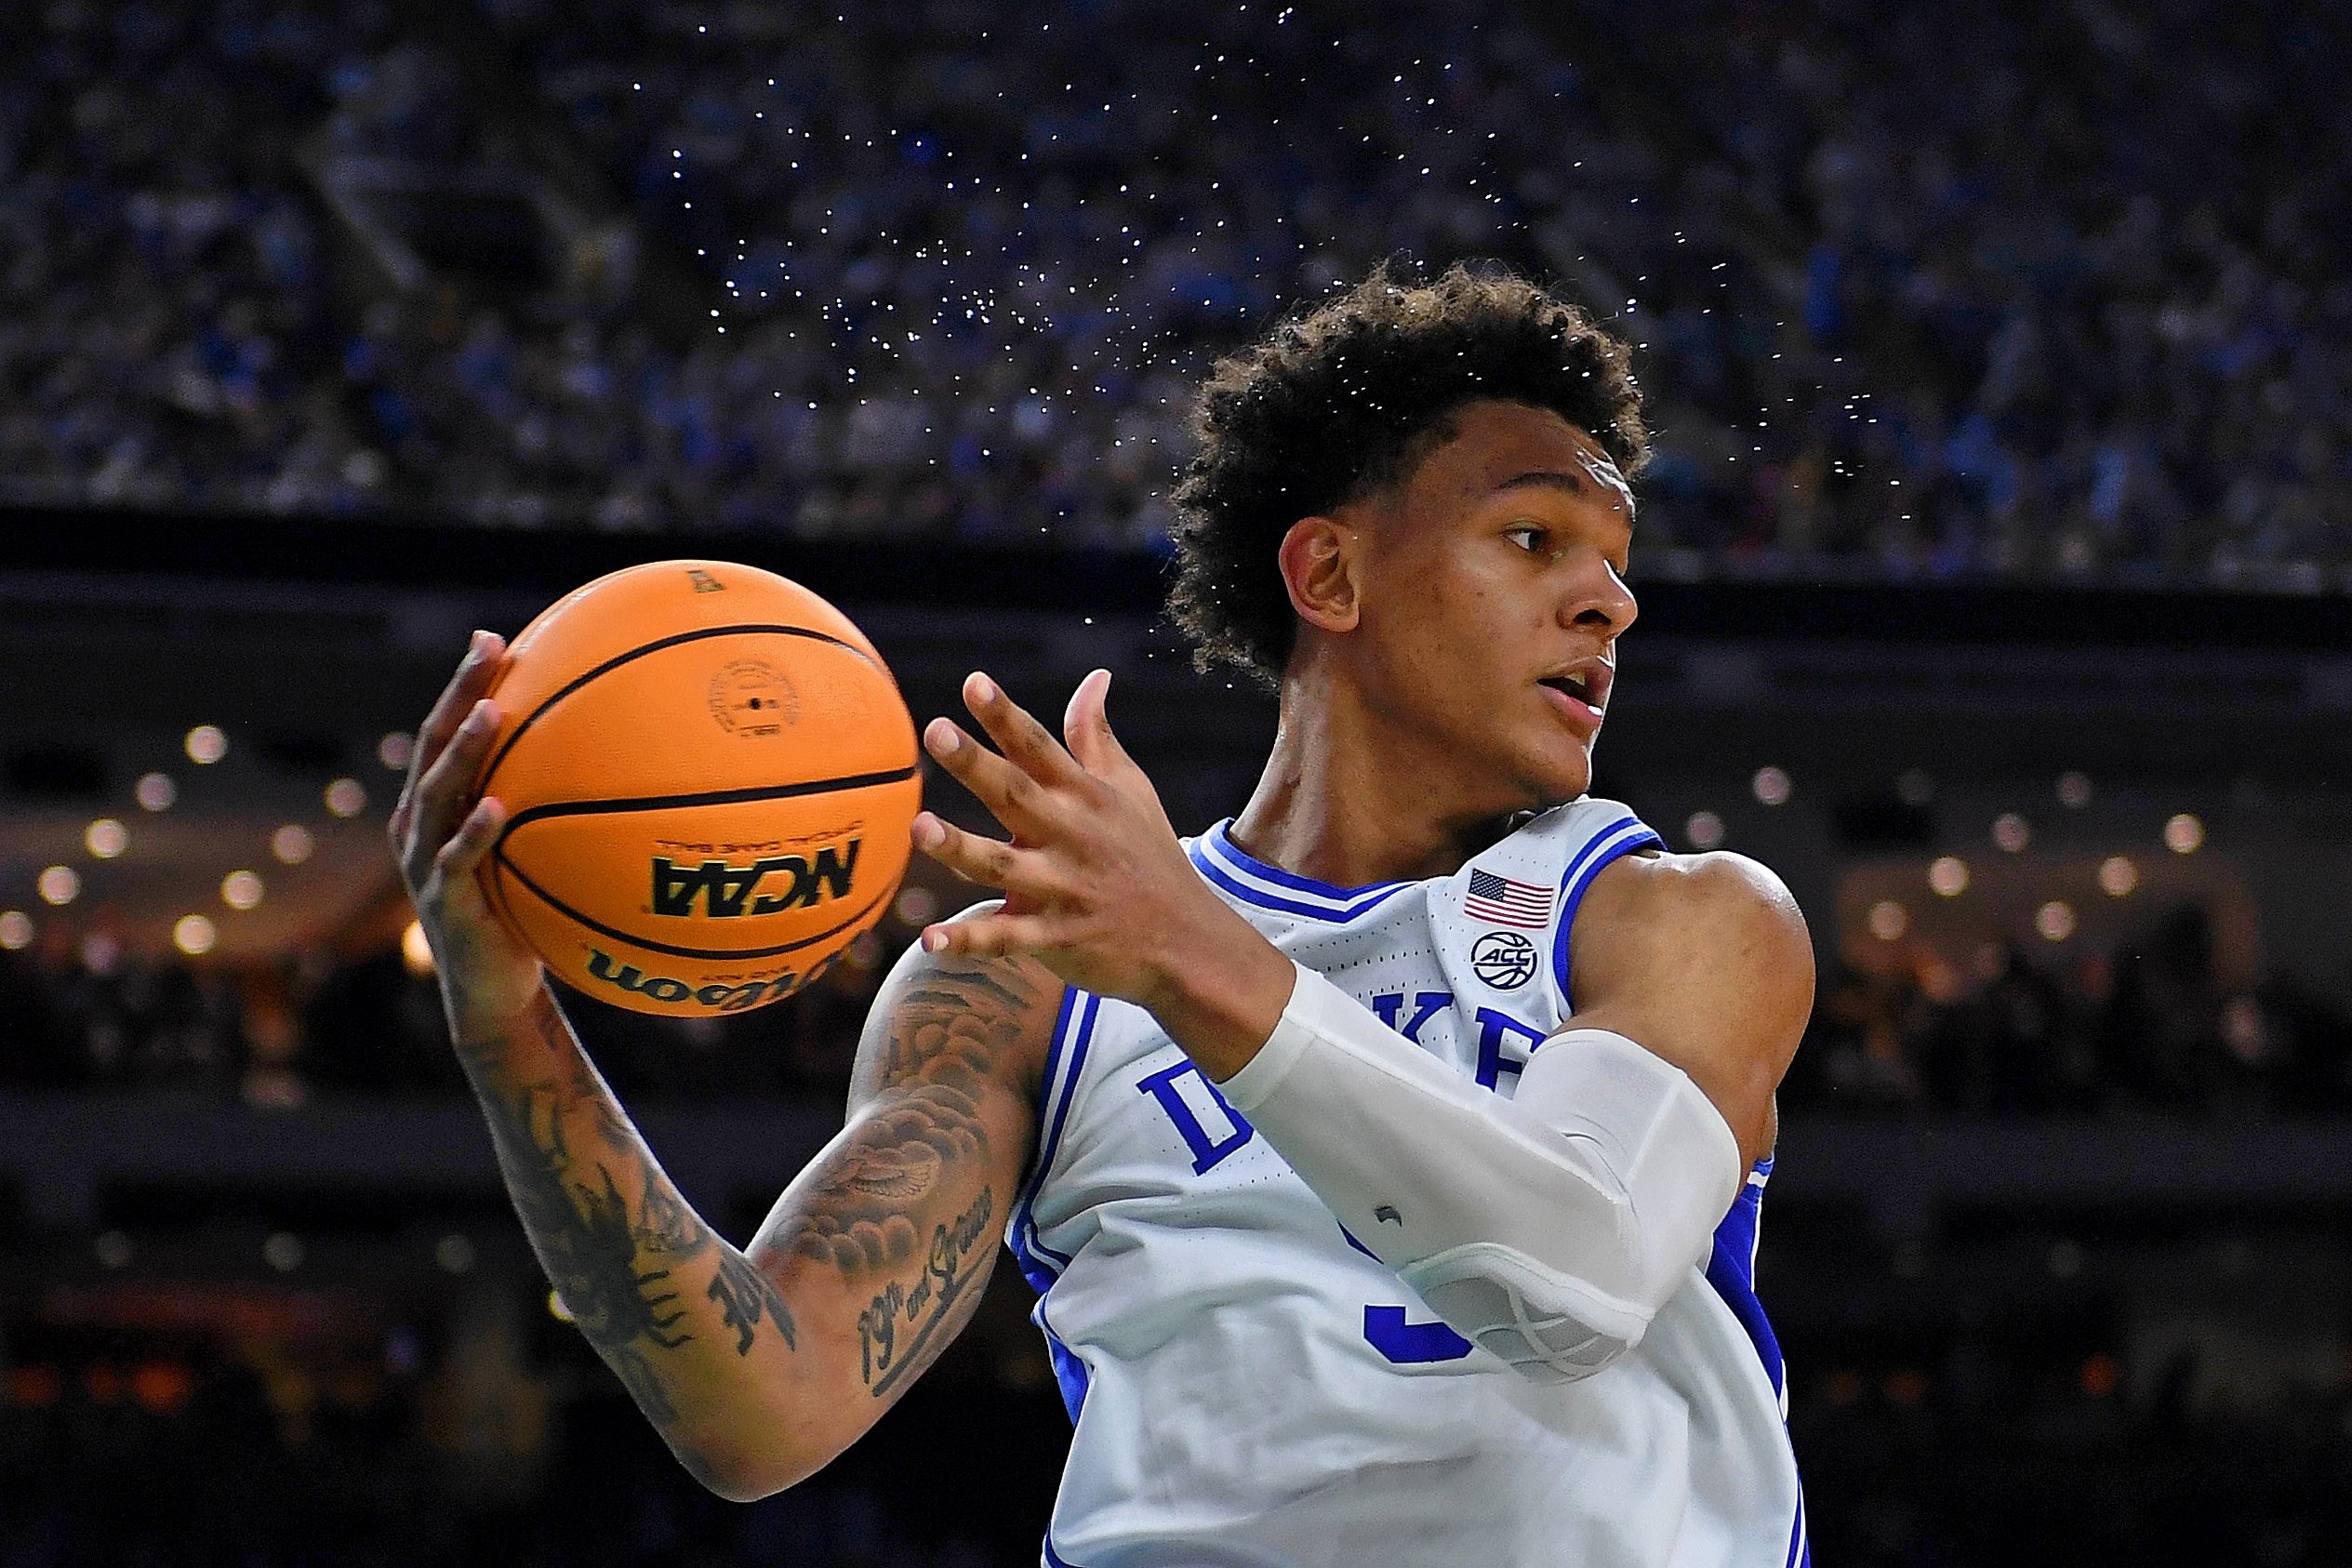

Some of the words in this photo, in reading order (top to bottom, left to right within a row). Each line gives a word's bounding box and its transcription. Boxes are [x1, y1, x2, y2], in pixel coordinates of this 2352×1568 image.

[654, 837, 861, 919] NCAA
[1480, 949, 1534, 965] ACC
[1136, 992, 1548, 1176] DKE
